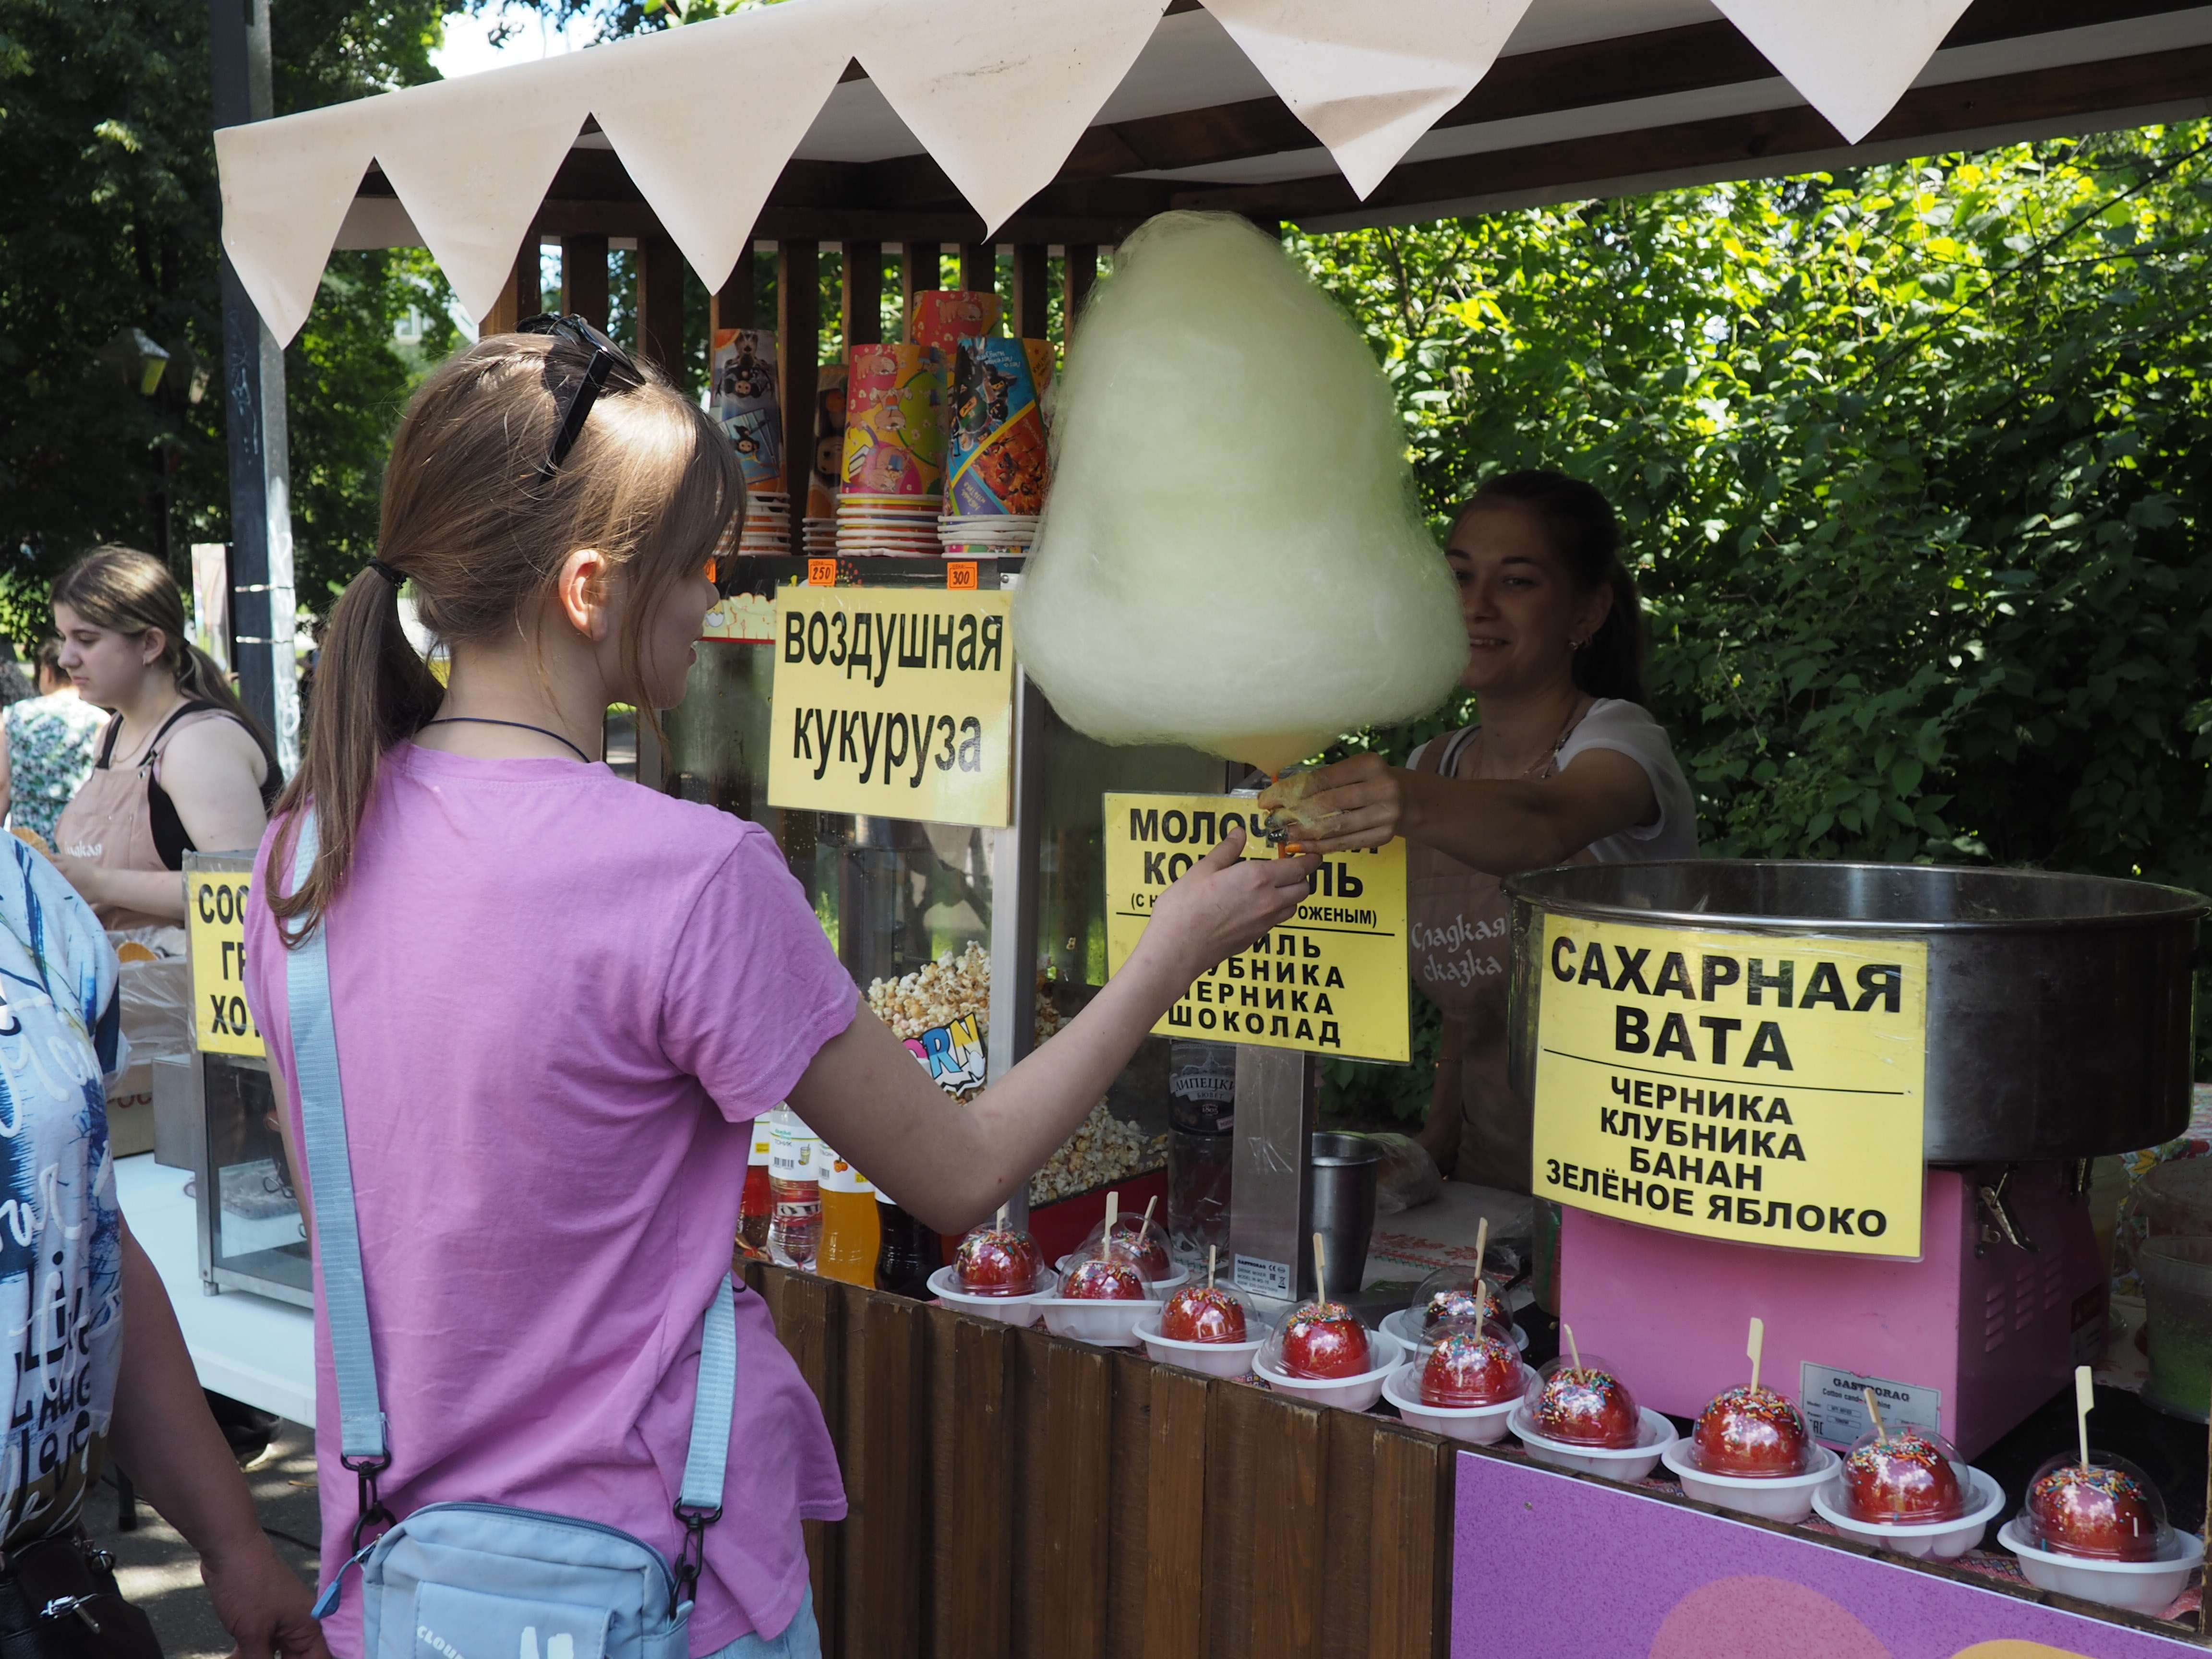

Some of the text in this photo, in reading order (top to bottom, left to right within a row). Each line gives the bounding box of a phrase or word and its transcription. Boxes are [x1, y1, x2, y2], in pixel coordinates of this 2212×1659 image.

[812, 566, 831, 580] 250
[953, 571, 970, 585] 300
[784, 611, 1003, 688] воздушная
[793, 707, 981, 788] кукуруза
[1130, 808, 1378, 854] МОЛОЧ
[1144, 851, 1363, 898] КОЛЬ
[1298, 905, 1377, 929] ОЖЕНЫМ)
[1411, 914, 1506, 953] Сладкая
[1253, 933, 1320, 958] ИЛЬ
[1551, 936, 1902, 1014] САХАРНАЯ
[210, 994, 261, 1037] ХО
[1168, 1005, 1341, 1048] ШОКОЛАД
[1615, 1005, 1794, 1071] ВАТА
[1611, 1076, 1793, 1126] ЧЕРНИКА
[1600, 1107, 1807, 1162] КЛУБНИКА
[1630, 1146, 1763, 1192] БАНАН
[1546, 1158, 1887, 1238] ЗЕЛЁНОЕ ЯБЛОКО
[1844, 1394, 1863, 1403] cand
